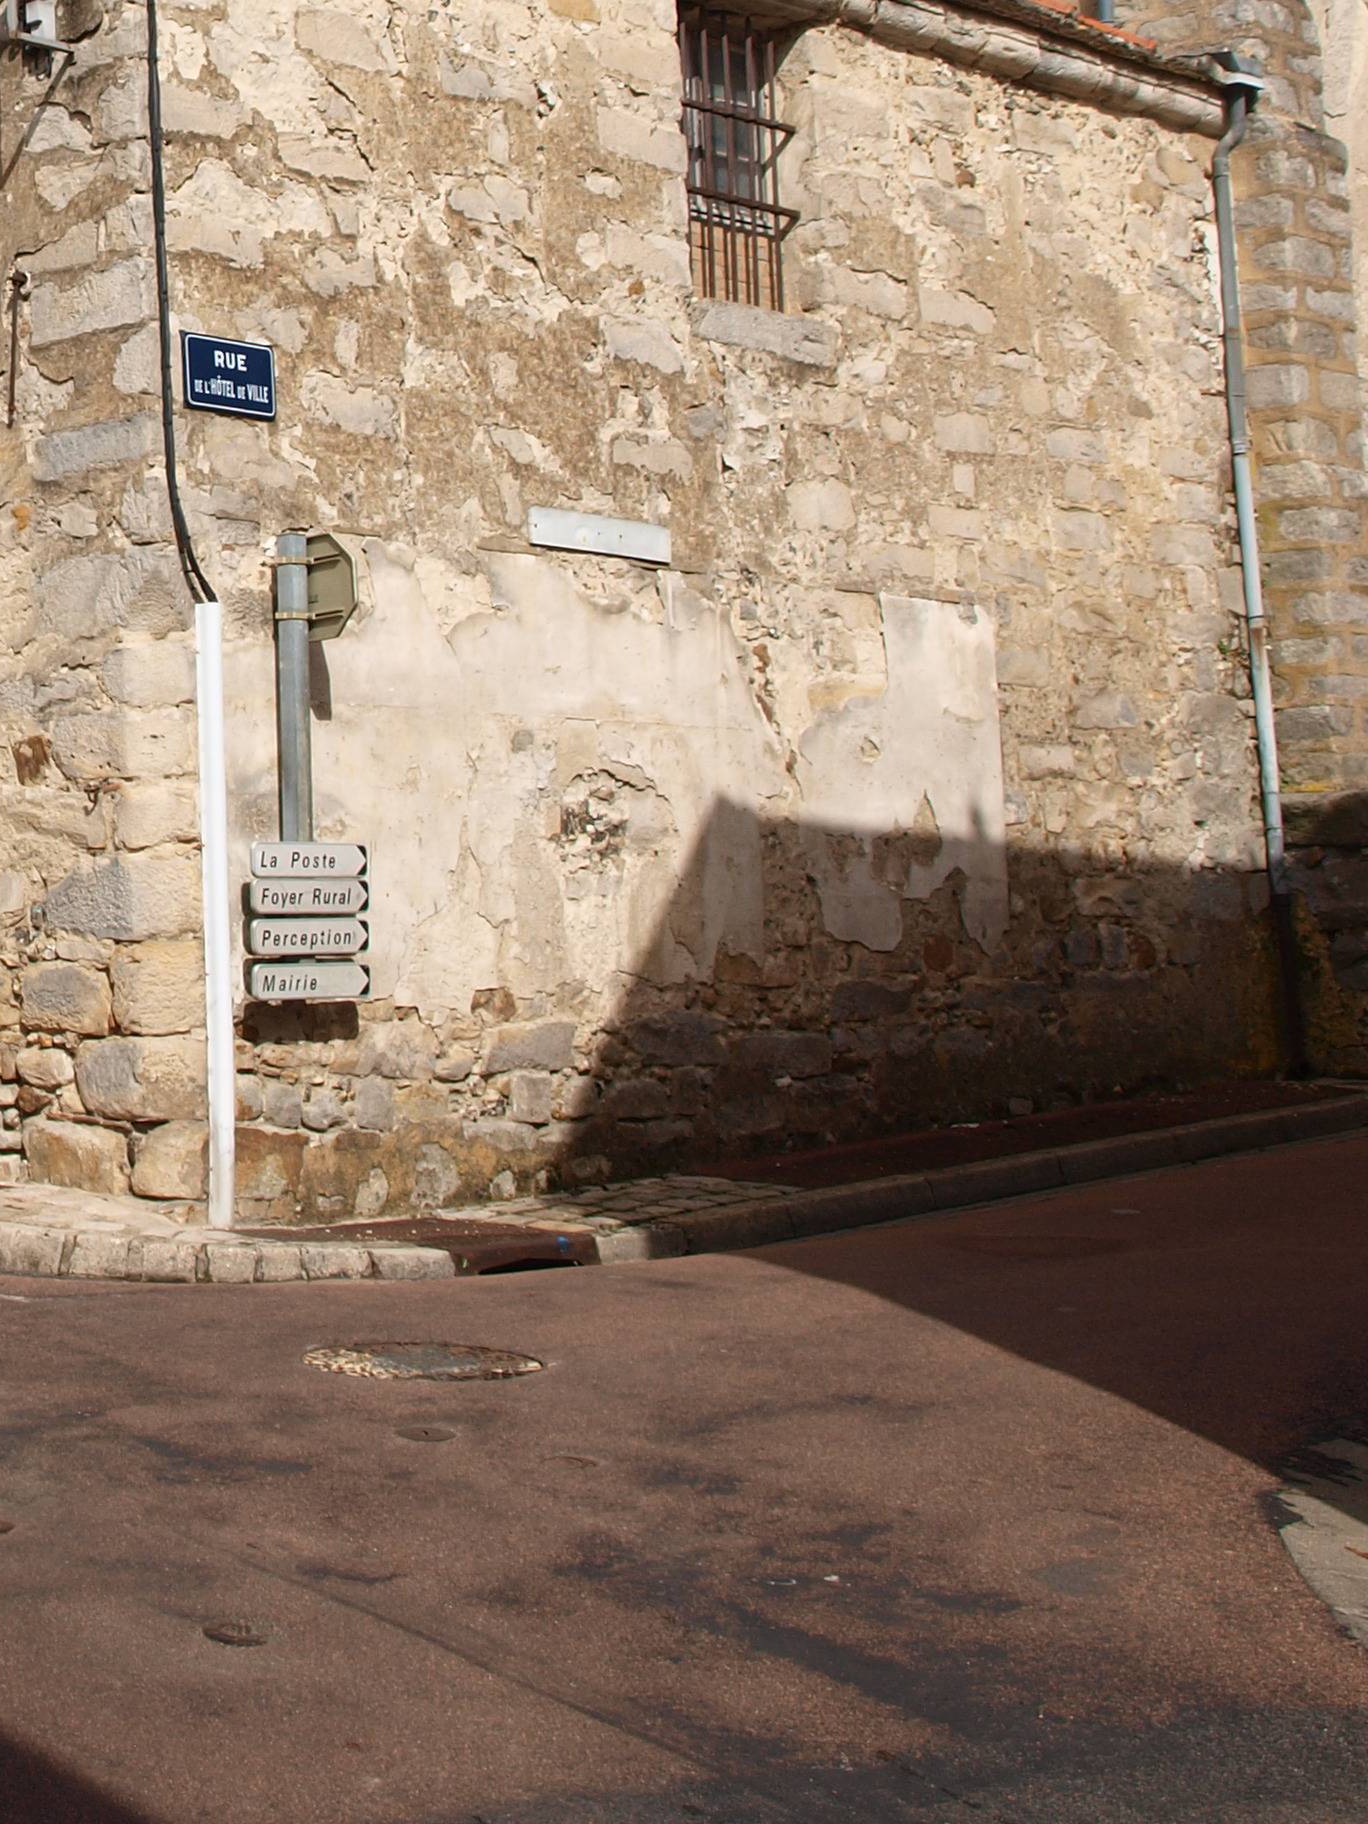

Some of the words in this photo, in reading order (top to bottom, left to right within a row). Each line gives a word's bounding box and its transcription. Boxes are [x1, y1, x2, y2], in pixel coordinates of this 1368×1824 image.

[214, 350, 247, 371] RUE
[246, 384, 268, 403] VILLE
[261, 851, 277, 868] La
[291, 851, 336, 868] Poste
[261, 888, 303, 908] Foyer
[312, 888, 351, 905] Rural
[262, 929, 352, 949] Perception
[262, 975, 318, 992] Mairie
